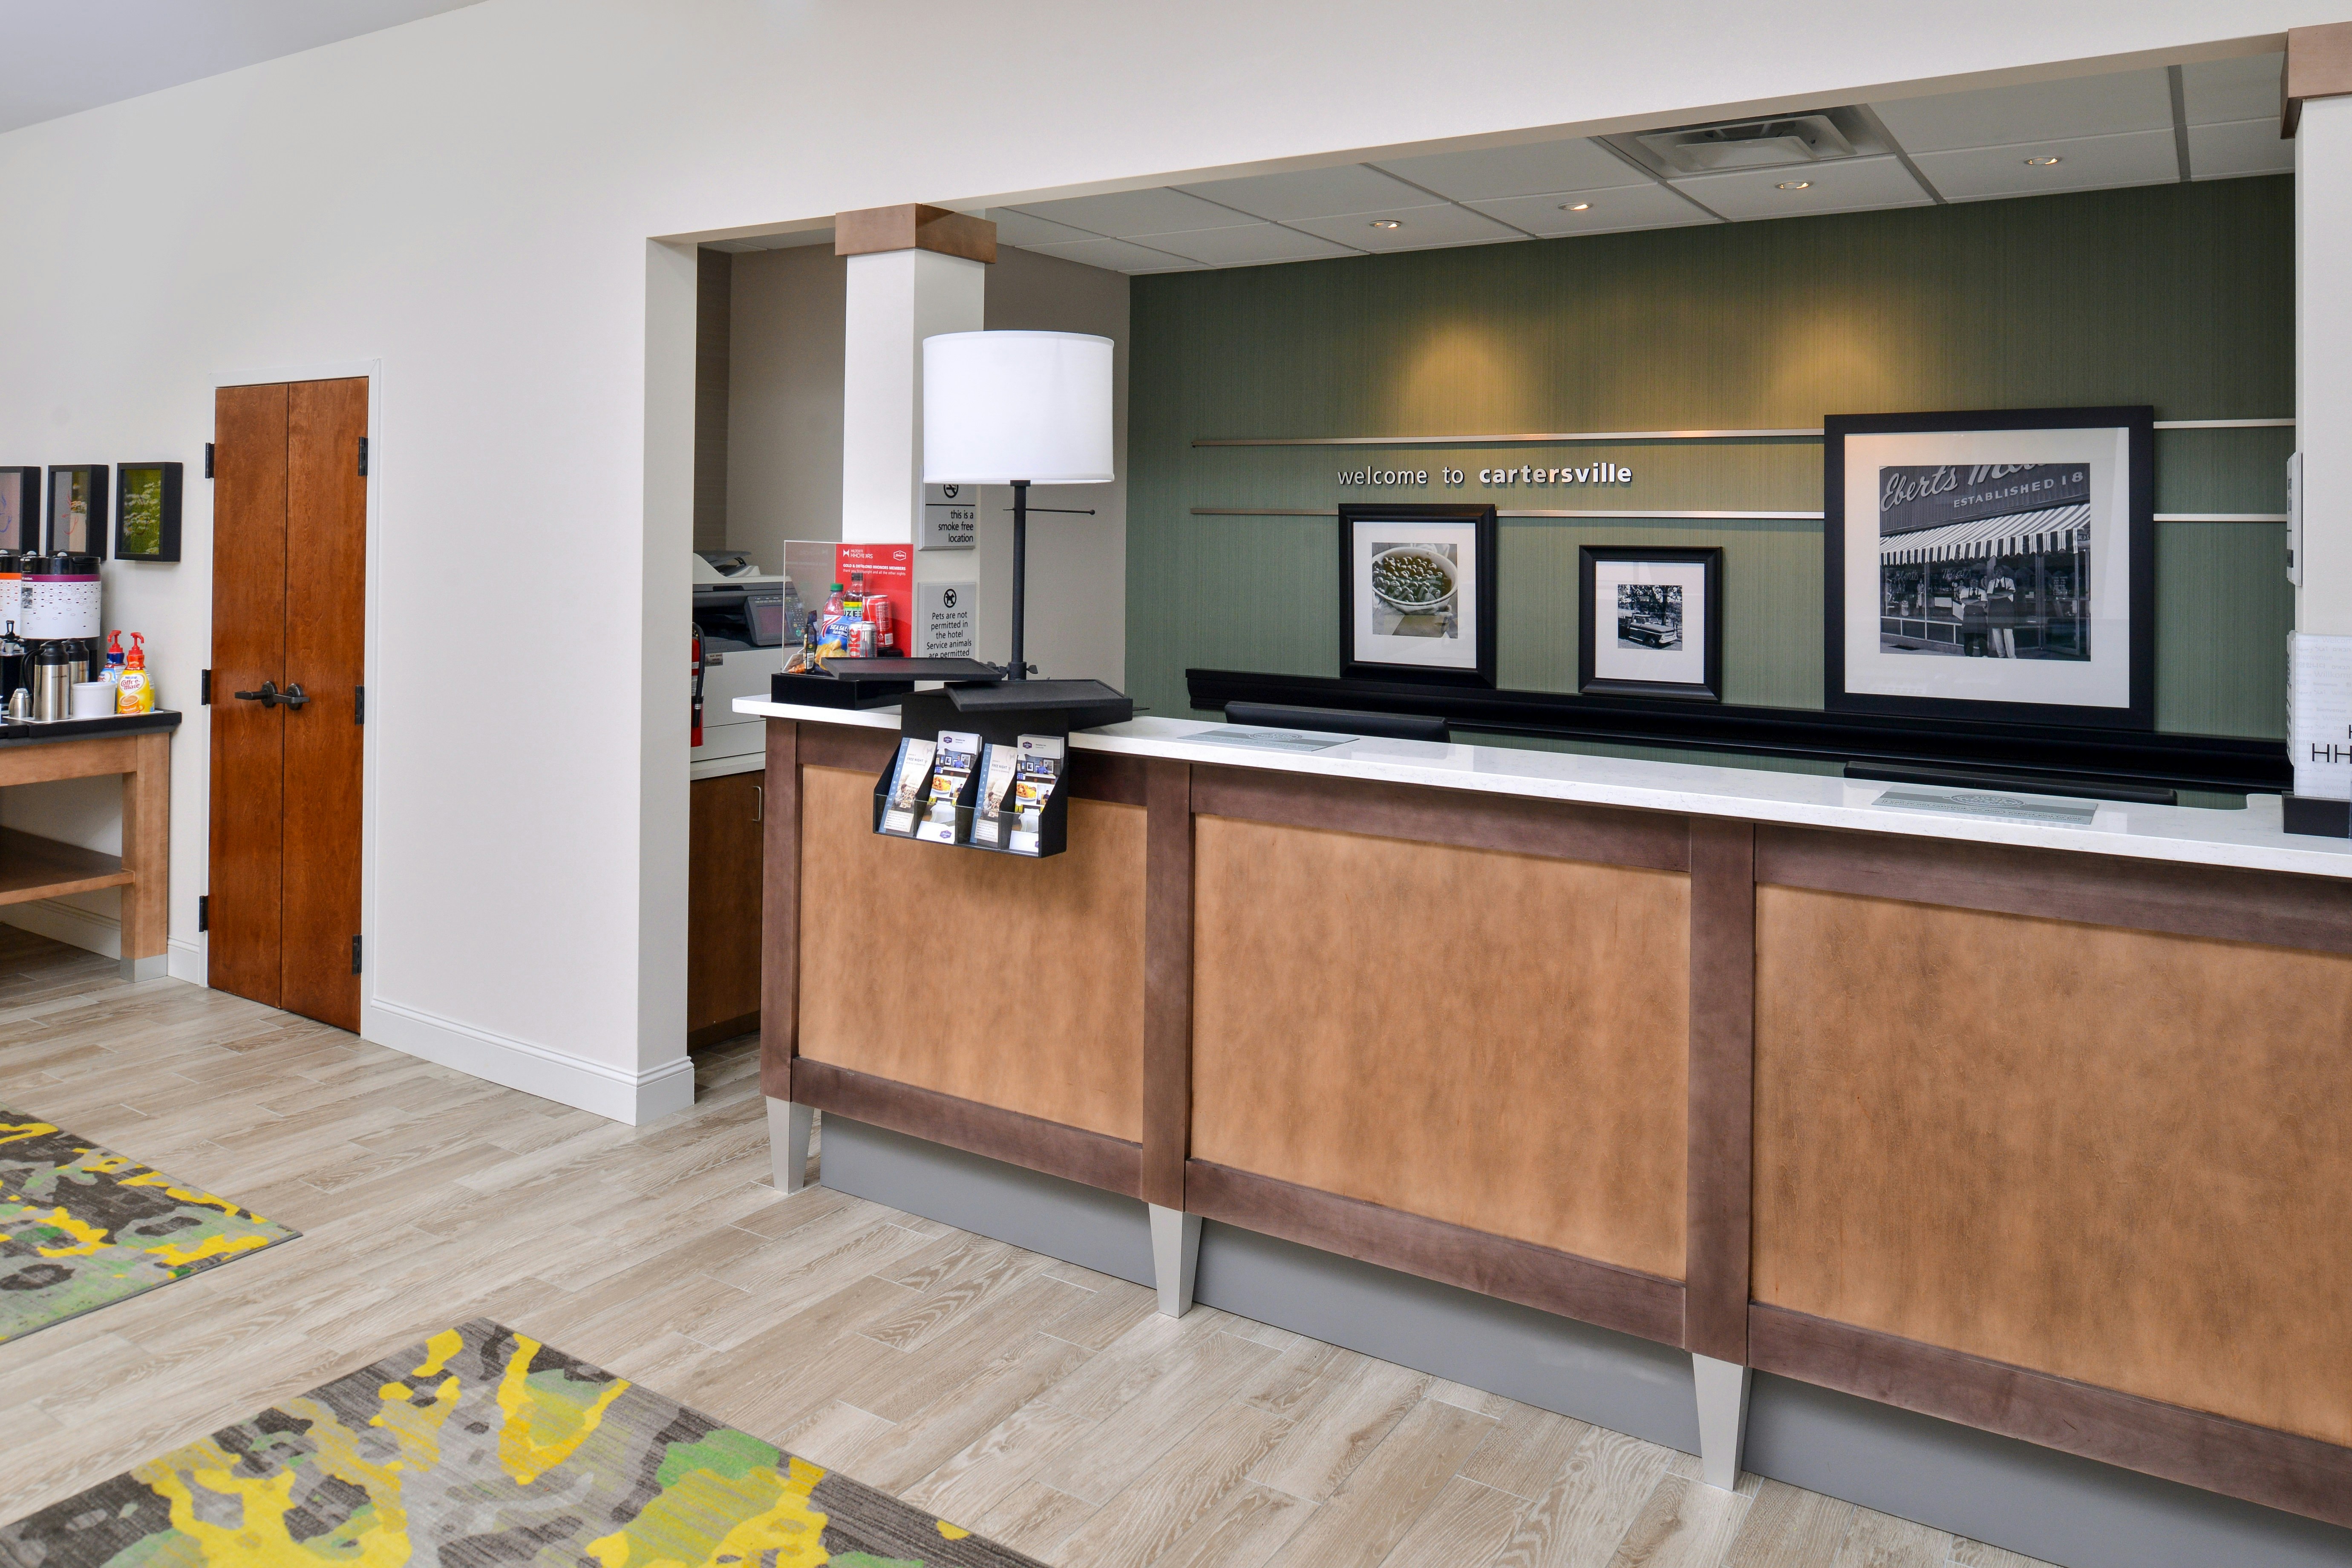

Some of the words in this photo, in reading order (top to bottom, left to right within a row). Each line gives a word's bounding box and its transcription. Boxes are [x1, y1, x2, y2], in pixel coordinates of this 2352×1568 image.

[1337, 466, 1427, 485] welcome
[1442, 467, 1464, 484] to
[1479, 462, 1633, 484] cartersville
[1880, 465, 1958, 512] Eberts
[1954, 478, 2054, 508] ESTABLISHED
[950, 510, 962, 519] this
[964, 510, 968, 519] is
[938, 521, 959, 530] smoke
[961, 521, 974, 530] free
[948, 533, 973, 542] location
[931, 620, 960, 631] permitted
[936, 631, 946, 639] the
[948, 630, 963, 638] hotel
[927, 641, 948, 649] Service
[949, 638, 971, 648] animals
[940, 648, 969, 658] permitted
